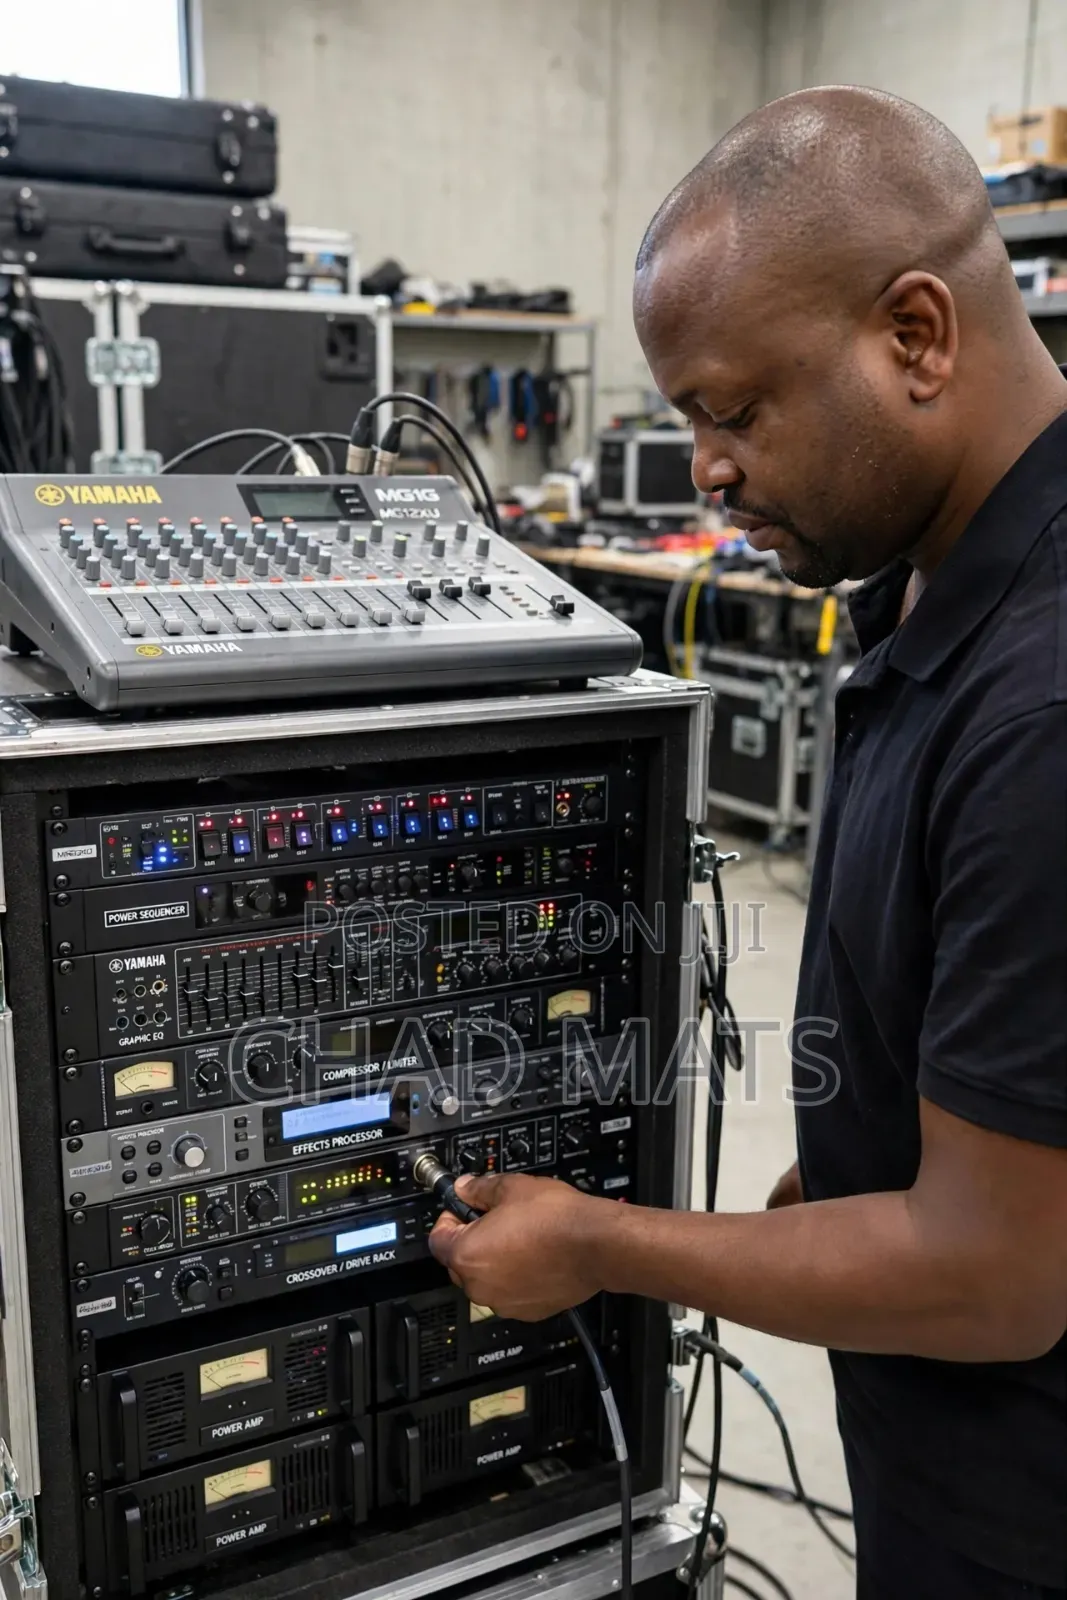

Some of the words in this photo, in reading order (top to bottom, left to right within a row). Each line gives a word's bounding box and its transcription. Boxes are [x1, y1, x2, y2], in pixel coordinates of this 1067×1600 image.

[63, 485, 162, 504] YAMAHA
[162, 642, 242, 655] YAMAHA
[108, 909, 138, 923] POWER
[139, 904, 186, 920] SEQUENCER
[124, 954, 166, 970] YAMAHA
[118, 1033, 151, 1046] GRAPHIC
[152, 1031, 164, 1040] EQ
[323, 1062, 380, 1080] COMPRESSOR
[387, 1056, 418, 1069] LIMITER
[292, 1139, 330, 1156] EFFECTS
[332, 1129, 383, 1148] PROCESSOR
[286, 1265, 338, 1284] CROSSOVER
[346, 1256, 371, 1271] DRIVE
[372, 1250, 396, 1263] RACK
[478, 1350, 506, 1365] POWER
[506, 1345, 523, 1357] AMP
[212, 1422, 243, 1438] POWER
[244, 1416, 264, 1430] AMP
[477, 1450, 504, 1466] POWER
[505, 1445, 522, 1457] AMP
[216, 1530, 247, 1547] POWER
[248, 1523, 267, 1537] AMP
